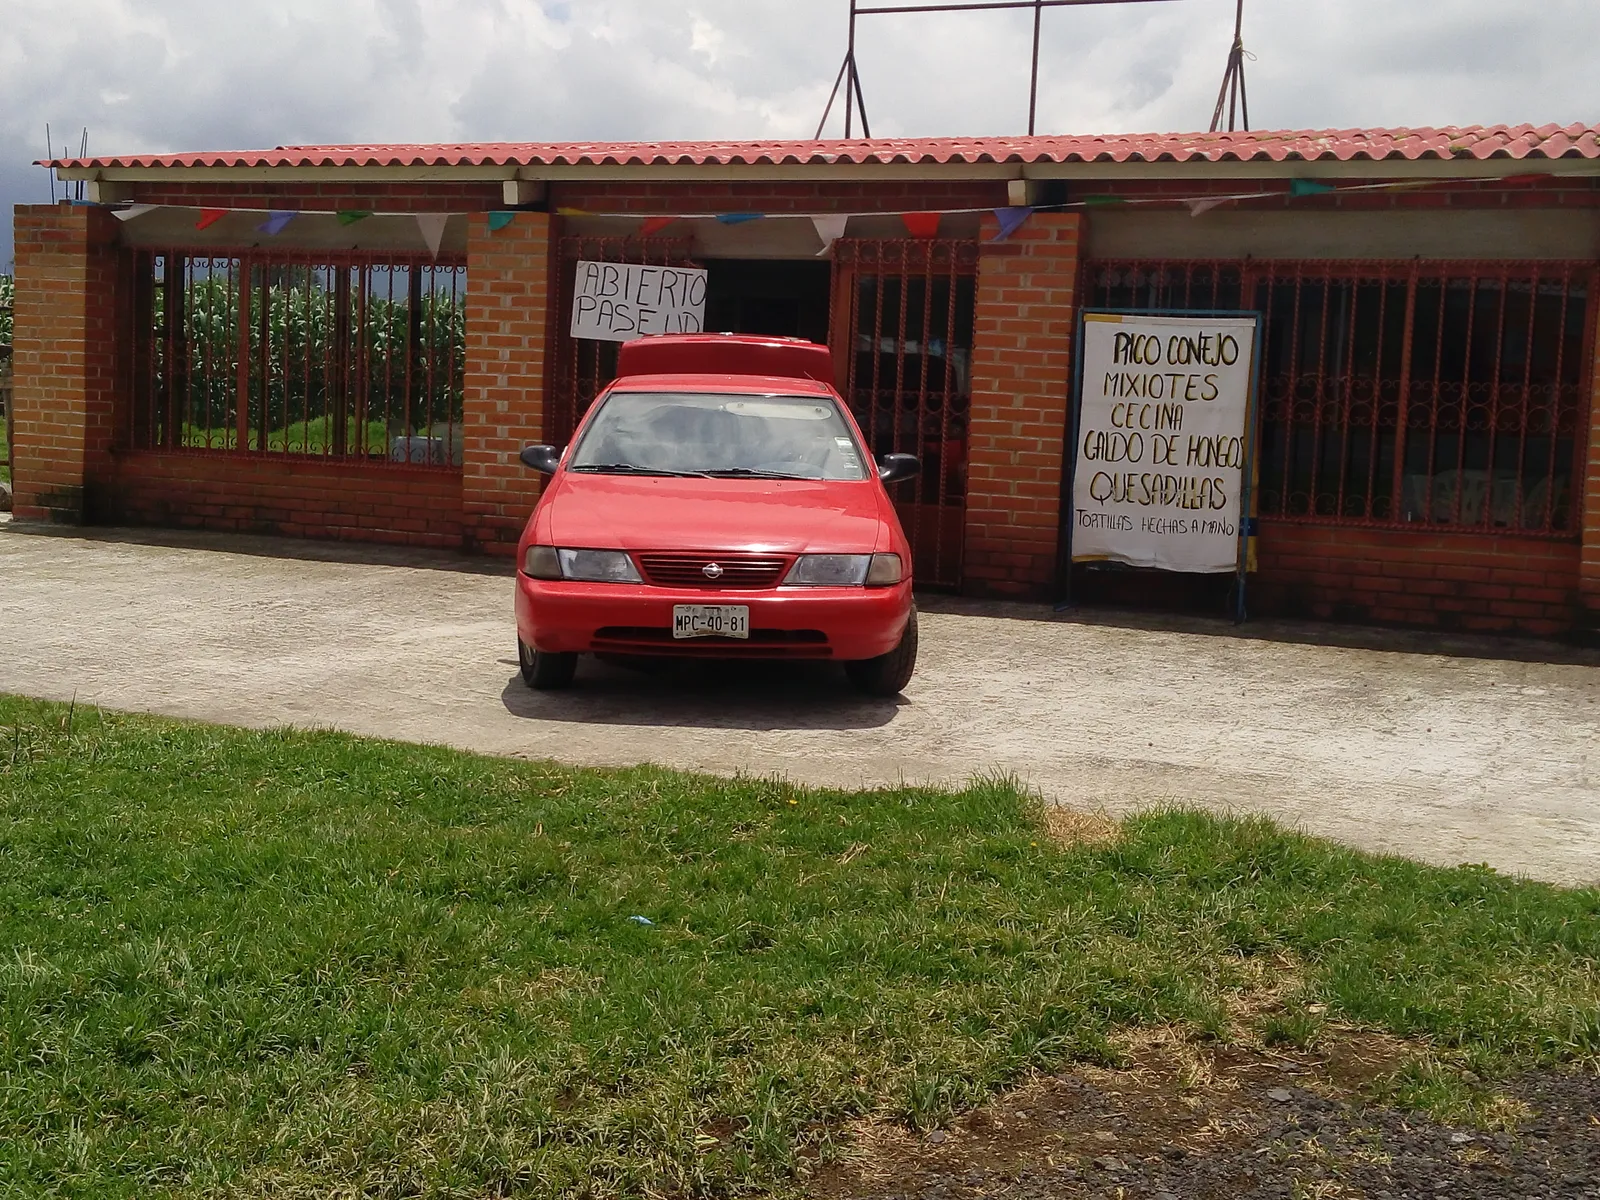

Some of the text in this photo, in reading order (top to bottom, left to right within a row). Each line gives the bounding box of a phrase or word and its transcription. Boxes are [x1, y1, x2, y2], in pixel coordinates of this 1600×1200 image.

[583, 263, 707, 308] ABIERTO
[576, 295, 657, 335] PASE
[1167, 331, 1239, 367] CONEJO
[1103, 371, 1219, 401] MIXIOTES
[1111, 402, 1184, 431] CECINA
[1083, 430, 1144, 463] CALDO
[1151, 433, 1180, 466] DE
[1089, 471, 1227, 511] QUESADILLAS
[1076, 508, 1234, 536] TORTILLAS HECHAS A MANO
[676, 615, 745, 632] MPC-40-81
